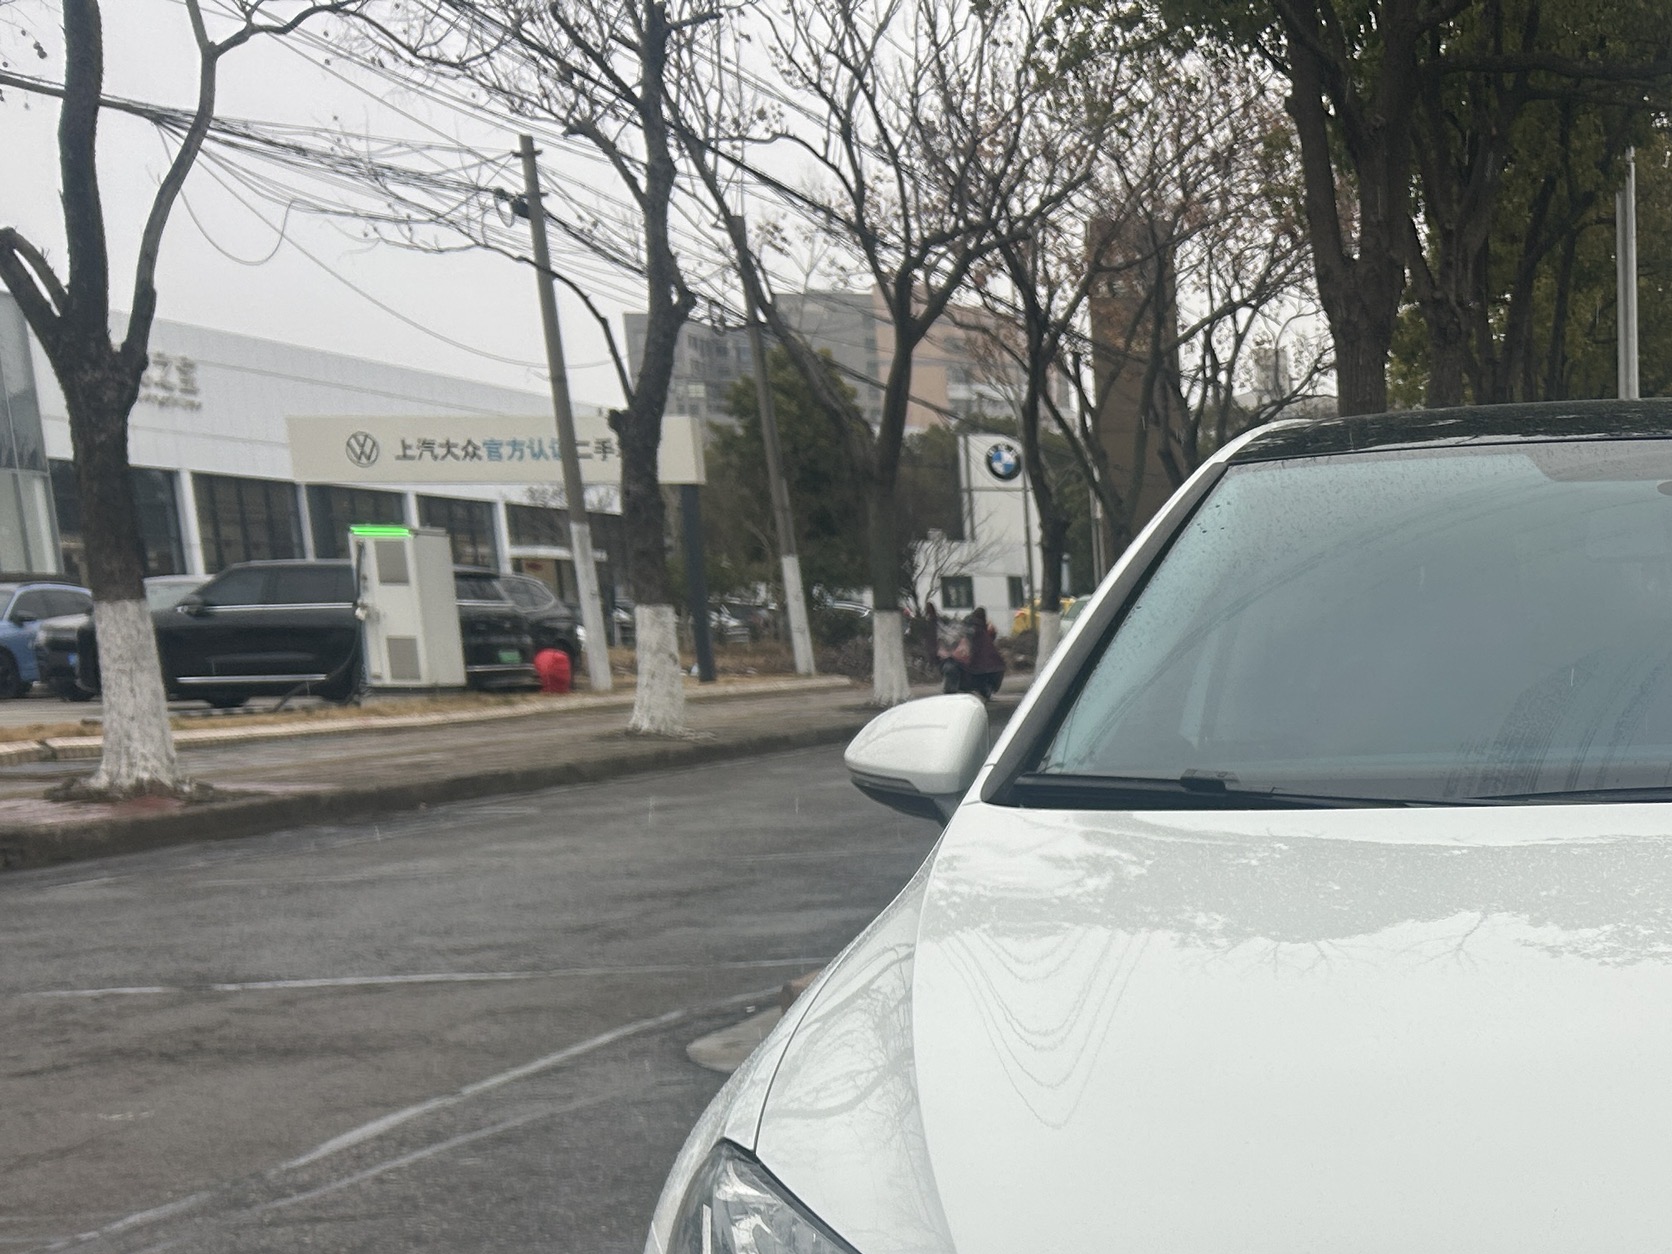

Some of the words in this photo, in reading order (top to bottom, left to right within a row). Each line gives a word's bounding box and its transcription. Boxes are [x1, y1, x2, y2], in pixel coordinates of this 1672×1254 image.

[395, 437, 622, 463] 上汽大众官方认二手
